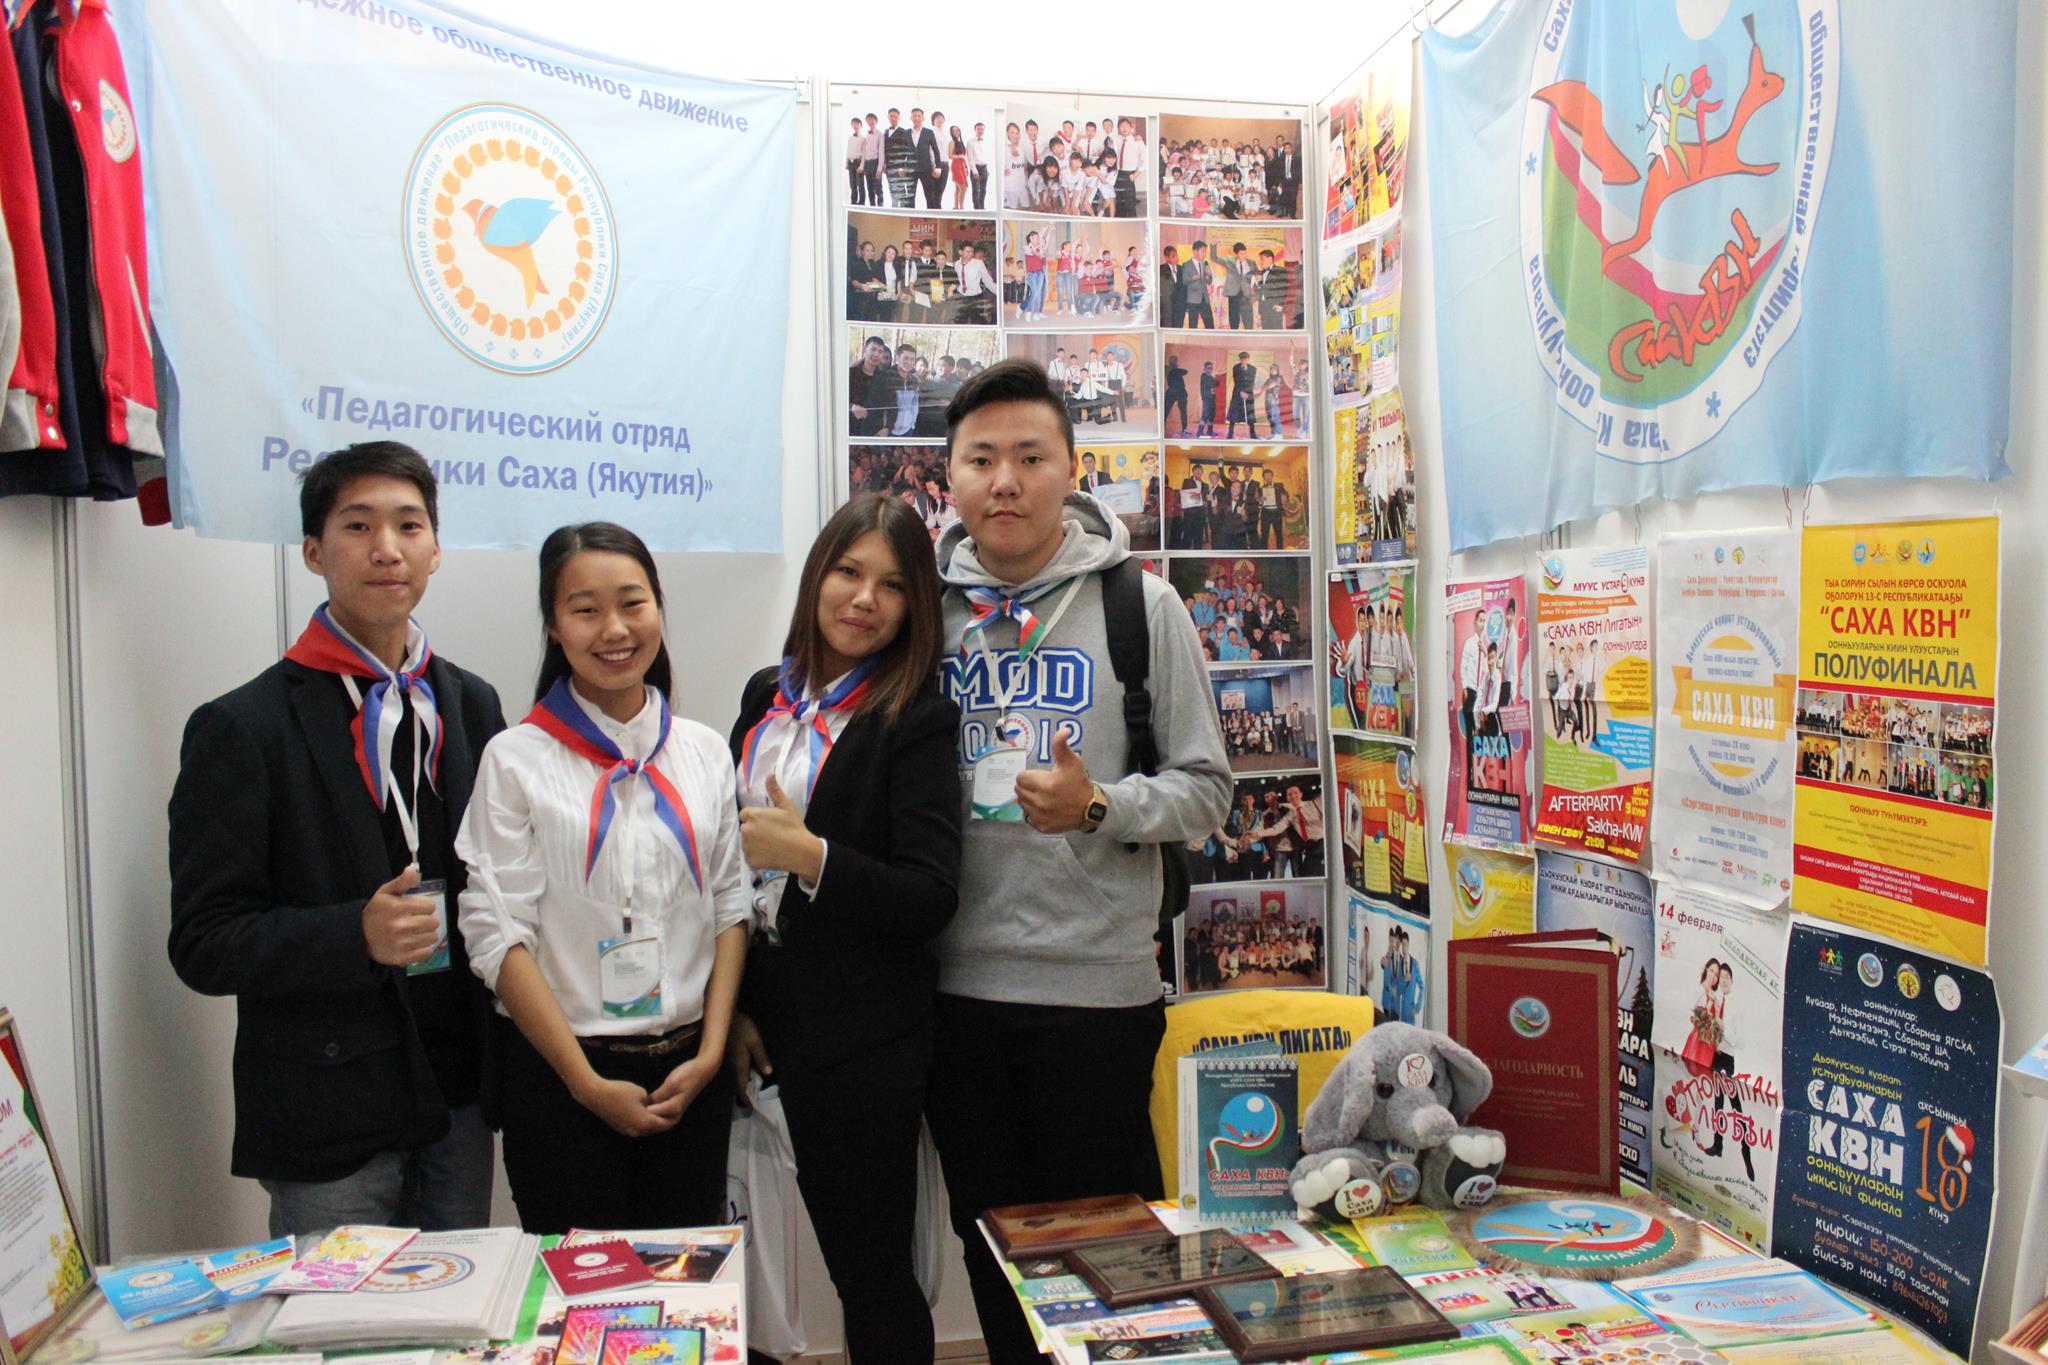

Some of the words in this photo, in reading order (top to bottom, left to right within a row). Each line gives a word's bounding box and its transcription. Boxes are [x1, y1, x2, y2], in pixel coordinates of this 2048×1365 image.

[432, 23, 632, 101] общественное
[638, 88, 749, 133] движение
[300, 385, 603, 444] «Педагогический
[611, 419, 691, 454] отряд
[498, 455, 577, 491] Саха
[586, 461, 713, 502] (Якутия)»
[1574, 582, 1598, 592] МУУС
[1825, 579, 1840, 588] ТЫА
[1841, 579, 1866, 588] СИРИН
[1867, 579, 1896, 588] СЫЛЫН
[1926, 579, 1967, 588] ОСКУОЛА
[1579, 620, 1602, 637] КВН
[1828, 640, 1885, 651] ООННЬУУЛАРЫН
[1886, 644, 1908, 652] КИИН
[1909, 645, 1960, 656] УЛУУСТАРЫН
[1814, 652, 1977, 690] ПОЛУФИНАЛА
[1692, 689, 1733, 725] САХА
[1740, 694, 1775, 729] КВН
[1474, 736, 1510, 758] САХА
[1549, 795, 1623, 812] AFTERPARTY
[1850, 804, 1880, 819] ООННЬУУ
[1586, 816, 1643, 843] Sakha-KVN
[1540, 869, 1577, 884] ДЬОКУУСКАЙ
[1580, 879, 1603, 890] КУОРАТ
[1659, 902, 1674, 920] 14
[1677, 911, 1724, 935] февраля
[1841, 1003, 1901, 1030] Нефтеняшки,
[1904, 1020, 1941, 1042] Сборная
[1945, 1035, 1976, 1056] ЯГСХА,
[1894, 1031, 1931, 1051] Сборная
[1487, 1059, 1584, 1079] ЛАГОДАРНОСТЬ
[1811, 1066, 1902, 1100] устудьуоннарын
[1812, 1052, 1865, 1076] Дьокуускай
[1868, 1069, 1902, 1086] куорат
[1807, 1079, 1906, 1137] САХА
[1917, 1101, 1967, 1128] ахсынньы
[1698, 1104, 1773, 1151] ЛЮБВИ
[1808, 1115, 1904, 1185] КВН
[1916, 1114, 1968, 1212] 18
[1806, 1154, 1904, 1199] оонньууларын
[1806, 1171, 1838, 1191] иккис
[1857, 1191, 1903, 1218] финала
[1812, 1244, 1854, 1271] билсэр
